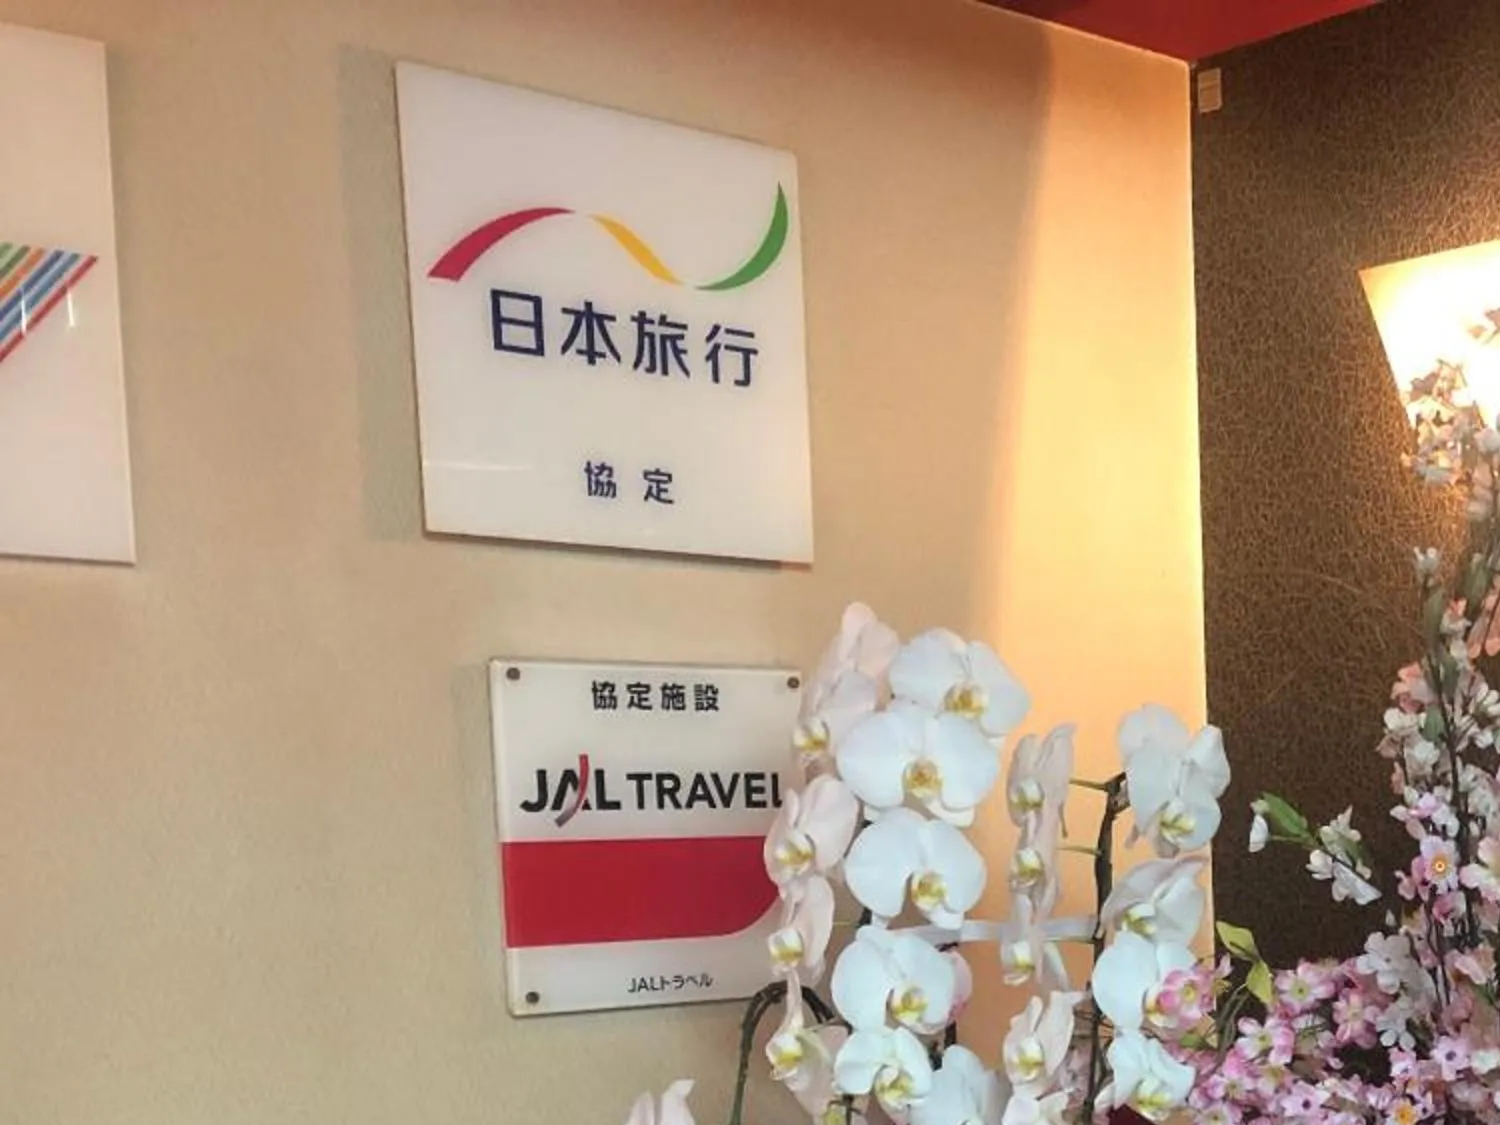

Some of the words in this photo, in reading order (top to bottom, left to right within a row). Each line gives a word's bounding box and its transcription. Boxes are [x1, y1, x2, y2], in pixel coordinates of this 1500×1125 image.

[490, 288, 758, 387] 日本旅行
[583, 460, 675, 504] 協定
[591, 679, 720, 712] 協定施設
[519, 753, 622, 828] JAL
[627, 973, 714, 994] JALトラベル
